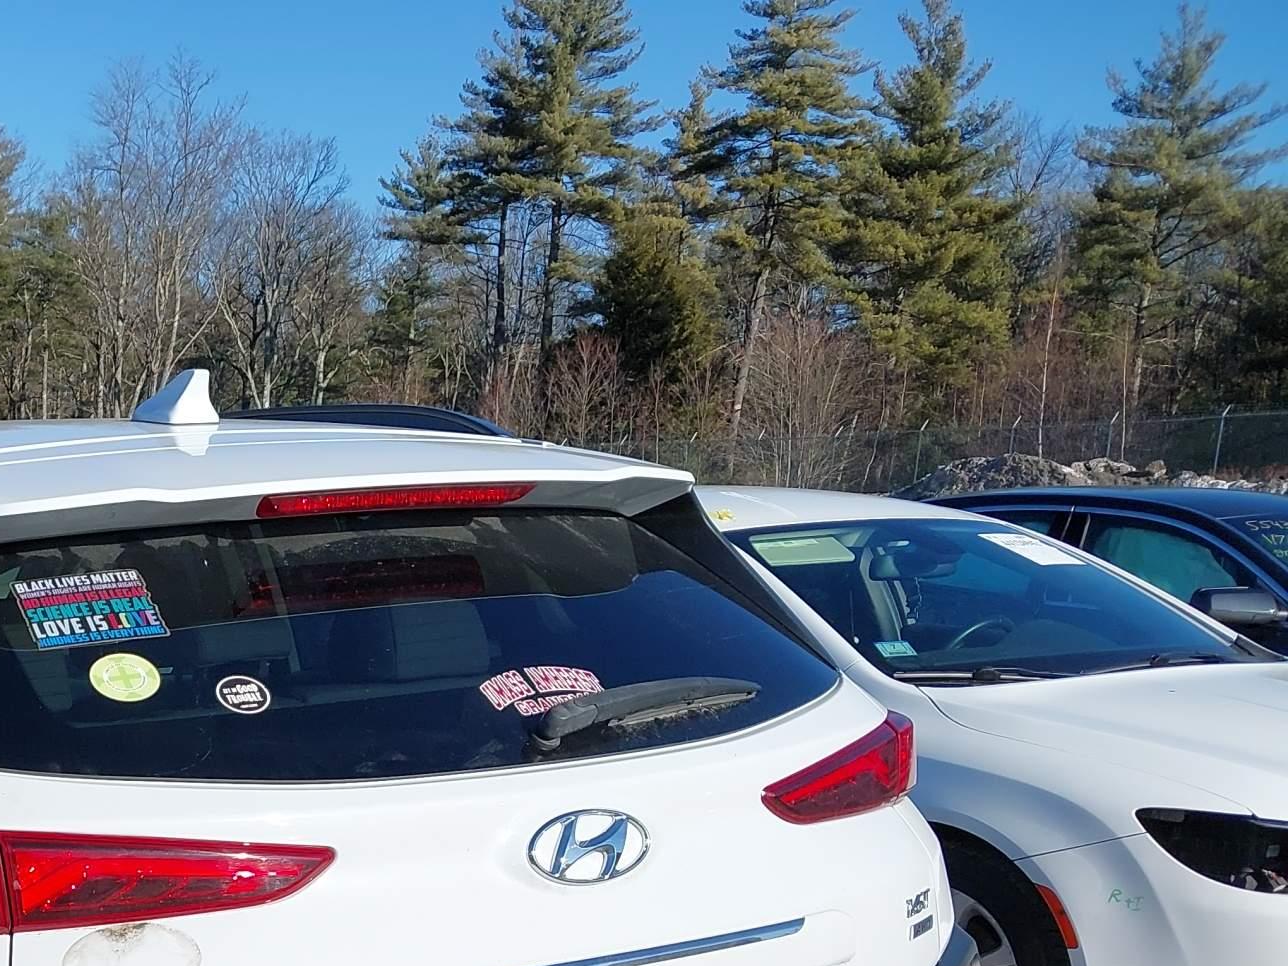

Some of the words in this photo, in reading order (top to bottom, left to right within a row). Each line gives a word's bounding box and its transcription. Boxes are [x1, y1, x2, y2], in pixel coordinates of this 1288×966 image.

[14, 579, 54, 594] BLACK
[55, 575, 90, 588] LIVES
[90, 571, 138, 584] MATTER
[26, 602, 92, 622] SCIENCE
[92, 600, 110, 615] IS
[110, 596, 153, 613] REAL
[32, 617, 85, 638] LOVE
[86, 614, 109, 632] IS
[108, 610, 161, 629] LOVE
[39, 633, 89, 648] KINDNESS
[90, 631, 101, 641] IS
[102, 625, 165, 640] EVERYTHING
[479, 670, 536, 711] UMASS
